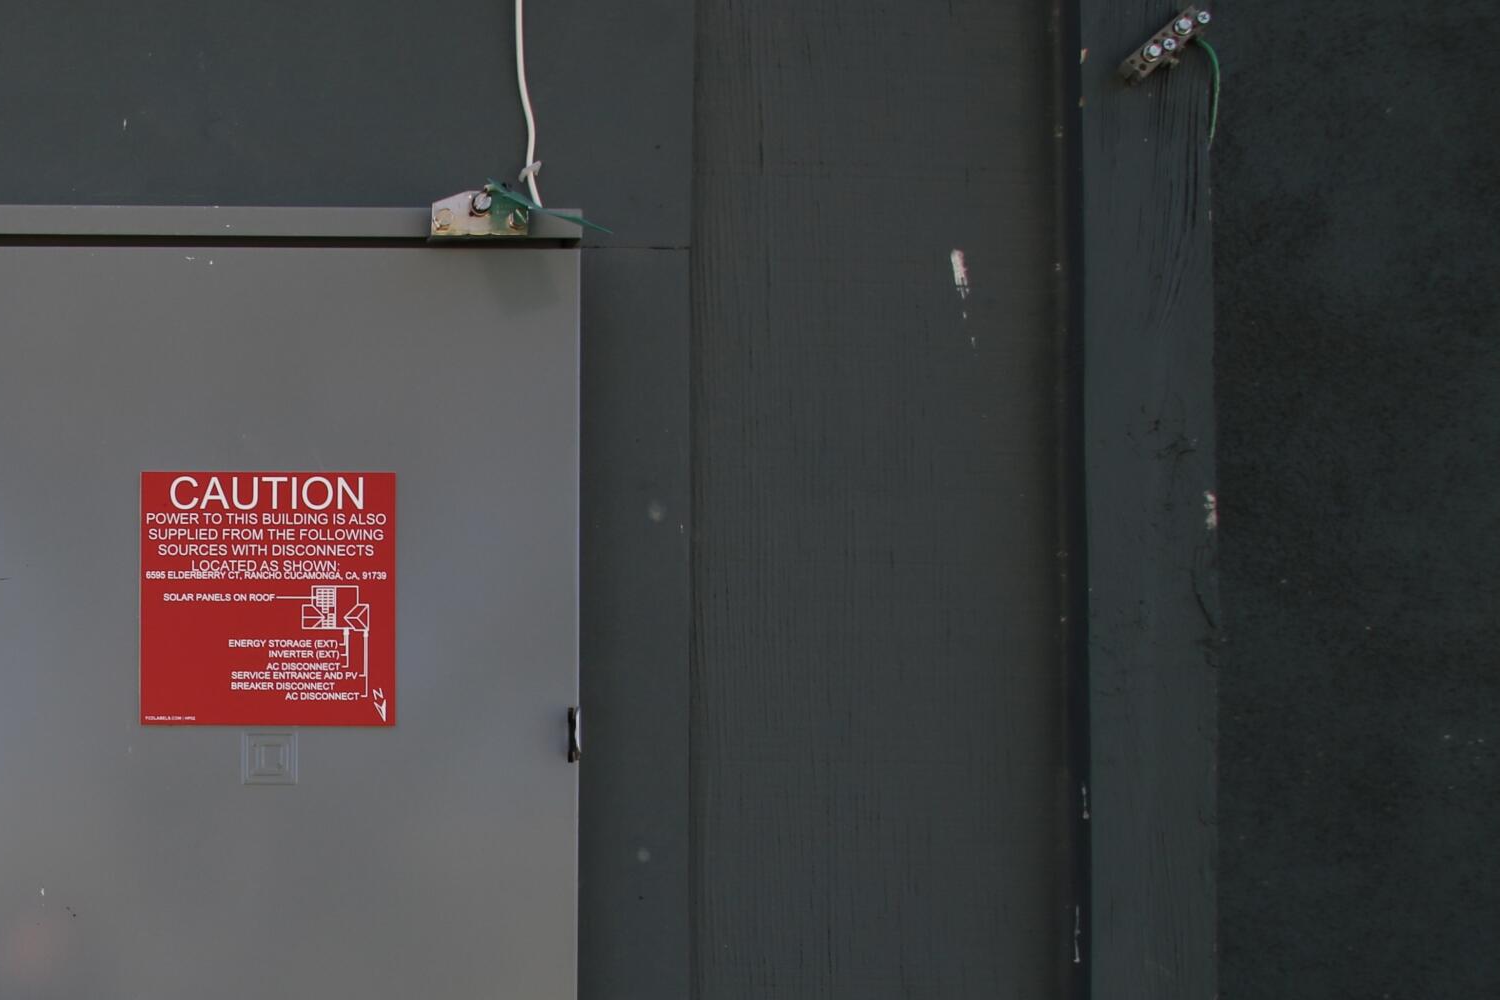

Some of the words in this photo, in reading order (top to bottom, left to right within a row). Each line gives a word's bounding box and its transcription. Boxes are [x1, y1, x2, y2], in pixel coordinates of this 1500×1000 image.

[170, 476, 364, 510] CAUTION
[147, 514, 198, 525] POWER
[203, 514, 222, 525] TO
[226, 514, 258, 525] THIS
[263, 514, 328, 525] BUILDING
[333, 514, 345, 525] IS
[349, 514, 386, 525] ALSO
[149, 529, 218, 540] SUPPLIED
[223, 529, 263, 540] FROM
[268, 529, 295, 540] THE
[300, 529, 384, 540] FOLLOWING
[158, 545, 227, 556] SOURCES
[232, 545, 267, 556] WITH
[272, 545, 374, 556] DISCONNECTS
[192, 560, 256, 571] LOCATED
[260, 560, 278, 571] AS
[283, 560, 340, 572] SHOWN:
[228, 572, 242, 580] CT,
[284, 572, 343, 580] CUCAMONGA,
[345, 572, 360, 580] CA,
[314, 640, 338, 649] (EXT)
[316, 651, 339, 659] (EXT)
[231, 682, 273, 690] BREAKER
[276, 682, 334, 690] DISCONNECT
